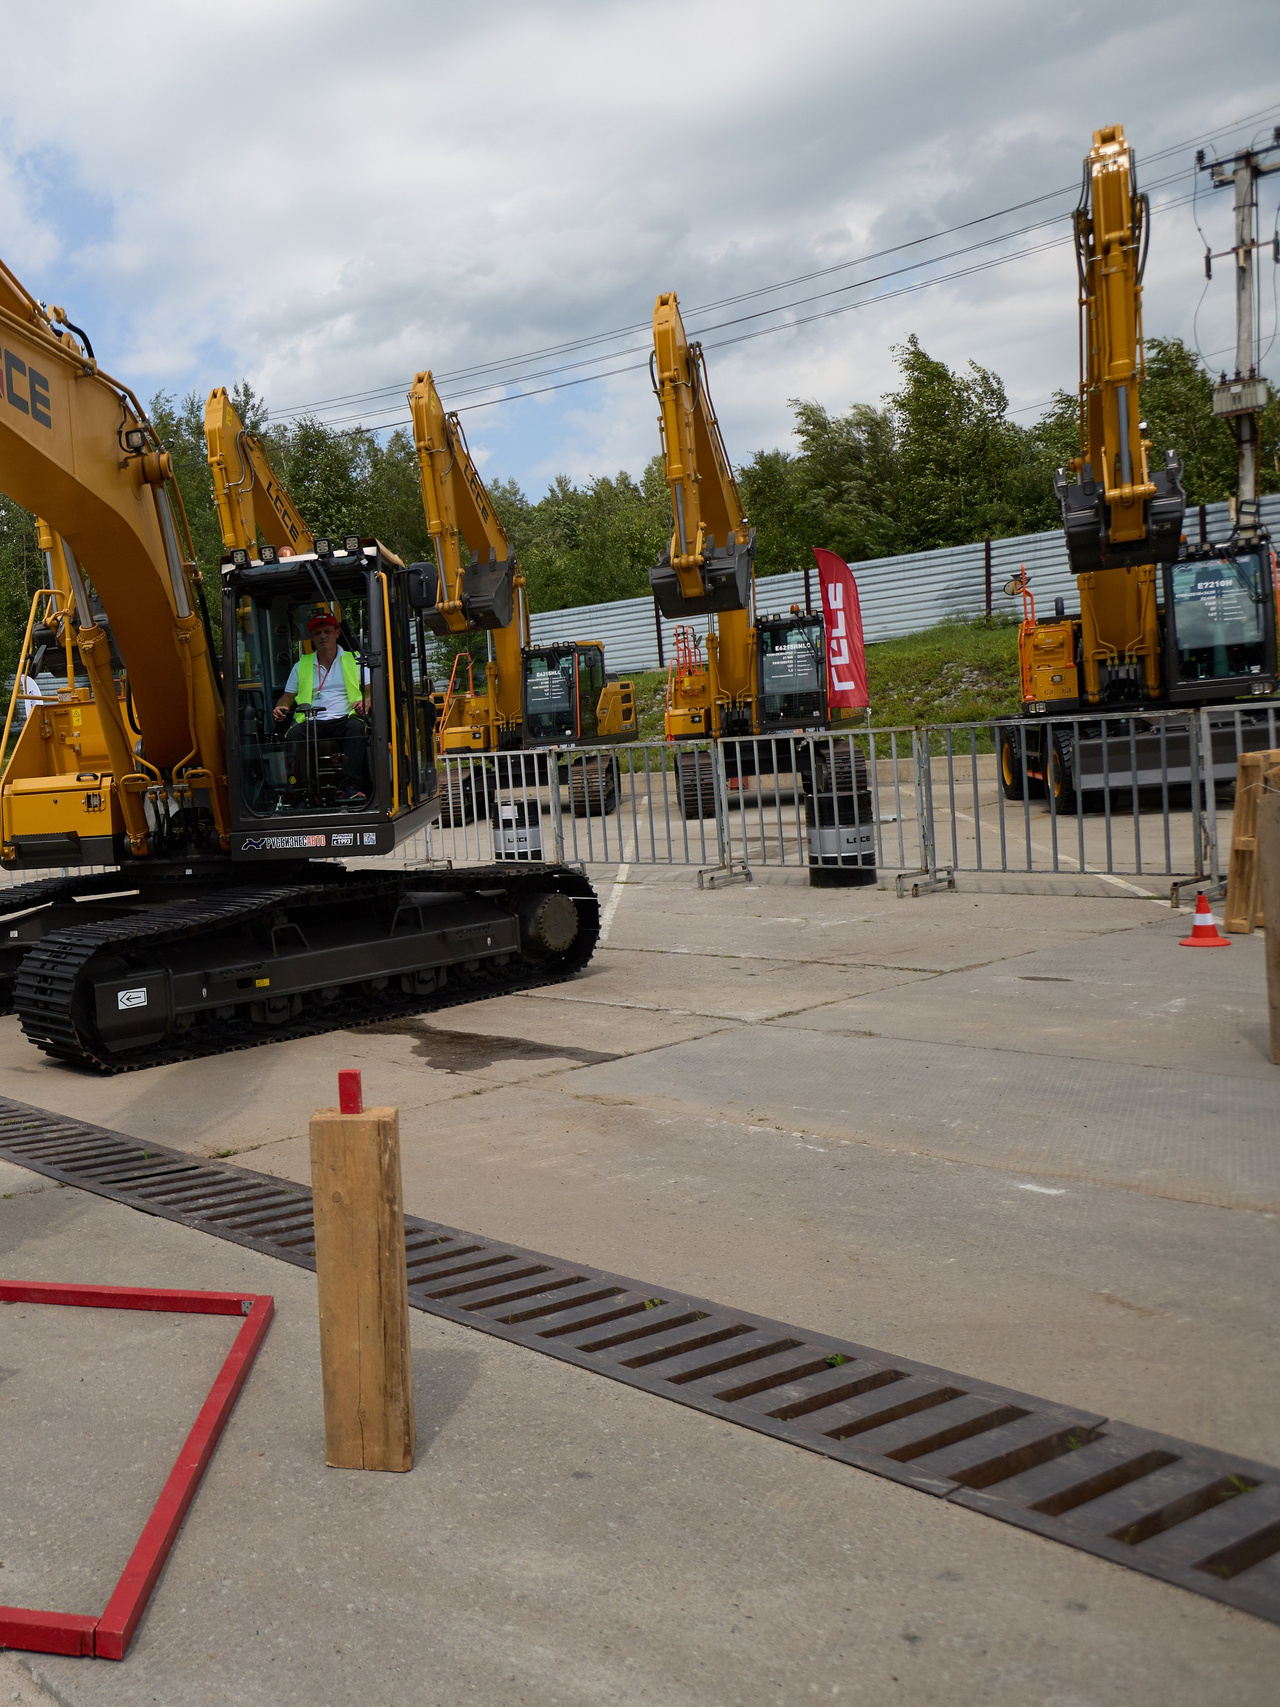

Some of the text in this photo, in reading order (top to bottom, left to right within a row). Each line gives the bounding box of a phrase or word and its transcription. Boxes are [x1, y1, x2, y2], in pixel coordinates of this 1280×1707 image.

[266, 480, 300, 542] LGCE
[463, 463, 490, 525] LGCE
[1197, 580, 1233, 590] E7210H
